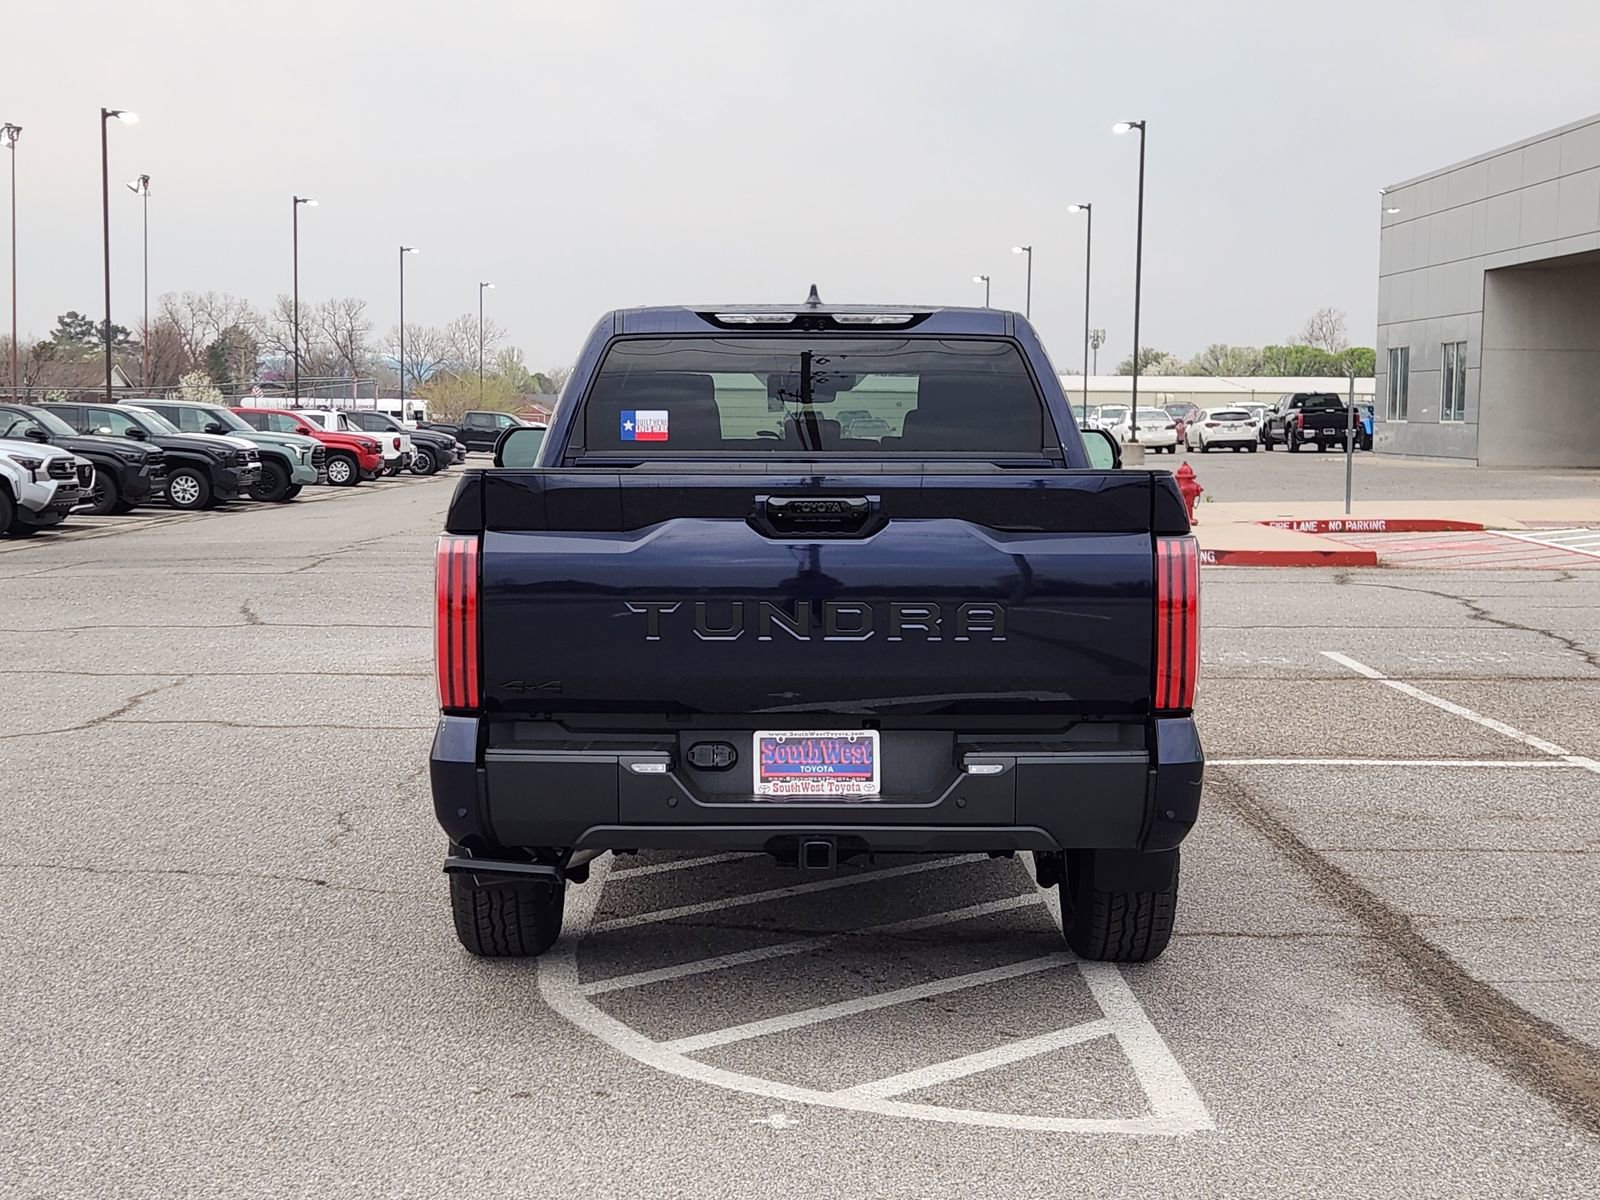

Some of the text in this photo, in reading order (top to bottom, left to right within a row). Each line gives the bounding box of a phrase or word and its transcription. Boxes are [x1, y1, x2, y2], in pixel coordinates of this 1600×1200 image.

[793, 501, 842, 512] TOYOTA
[1293, 521, 1318, 532] LANE
[1328, 521, 1342, 532] NO
[1345, 520, 1386, 531] PARKING
[623, 601, 1008, 641] TUNDRA
[800, 765, 835, 773] TOYOTA
[772, 782, 862, 796] SouthWest Toyota
